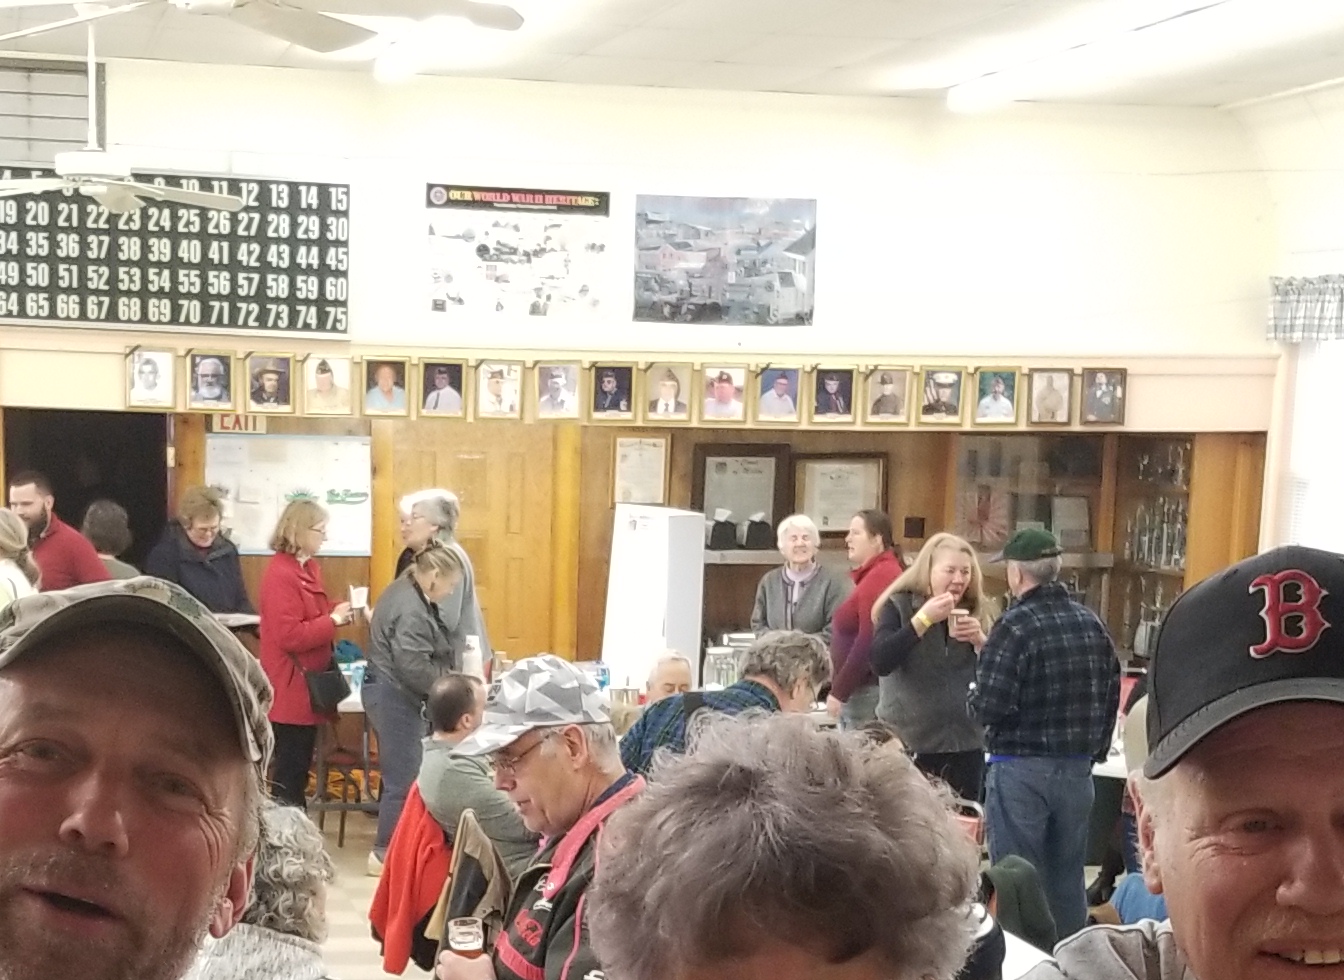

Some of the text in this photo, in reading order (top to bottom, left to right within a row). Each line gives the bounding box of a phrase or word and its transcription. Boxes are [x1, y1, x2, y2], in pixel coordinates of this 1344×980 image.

[239, 182, 259, 207] 12
[269, 184, 289, 208] 13
[298, 185, 318, 209] 14
[329, 187, 348, 211] 15
[473, 191, 511, 203] WORLD
[26, 201, 49, 225] 20
[58, 203, 77, 227] 21
[87, 204, 110, 229] 22
[118, 209, 141, 230] 23
[148, 208, 170, 231] 24
[178, 209, 200, 232] 25
[208, 210, 230, 234] 26
[238, 212, 260, 236] 27
[267, 214, 290, 238] 28
[297, 215, 319, 239] 29
[326, 216, 348, 241] 30
[26, 232, 48, 256] 35
[57, 233, 79, 257] 36
[87, 235, 109, 258] 37
[119, 237, 140, 260] 38
[148, 238, 170, 262] 39
[178, 240, 200, 263] 40
[209, 241, 229, 264] 41
[237, 243, 260, 266] 42
[267, 244, 289, 268] 43
[296, 246, 319, 269] 44
[325, 246, 348, 271] 45
[26, 263, 49, 286] 50
[59, 264, 77, 288] 51
[88, 266, 109, 289] 52
[119, 267, 140, 291] 53
[148, 268, 170, 292] 54
[179, 270, 200, 293] 55
[208, 271, 230, 295] 56
[238, 273, 260, 296] 57
[266, 274, 289, 298] 58
[296, 276, 318, 299] 59
[325, 276, 347, 301] 60
[26, 293, 49, 316] 65
[57, 294, 79, 318] 66
[87, 296, 109, 319] 67
[119, 297, 140, 321] 68
[149, 298, 170, 322] 69
[179, 300, 200, 323] 70
[209, 301, 229, 324] 71
[237, 303, 259, 326] 72
[267, 304, 288, 328] 73
[296, 306, 317, 329] 74
[325, 306, 347, 331] 75
[1248, 569, 1332, 659] B
